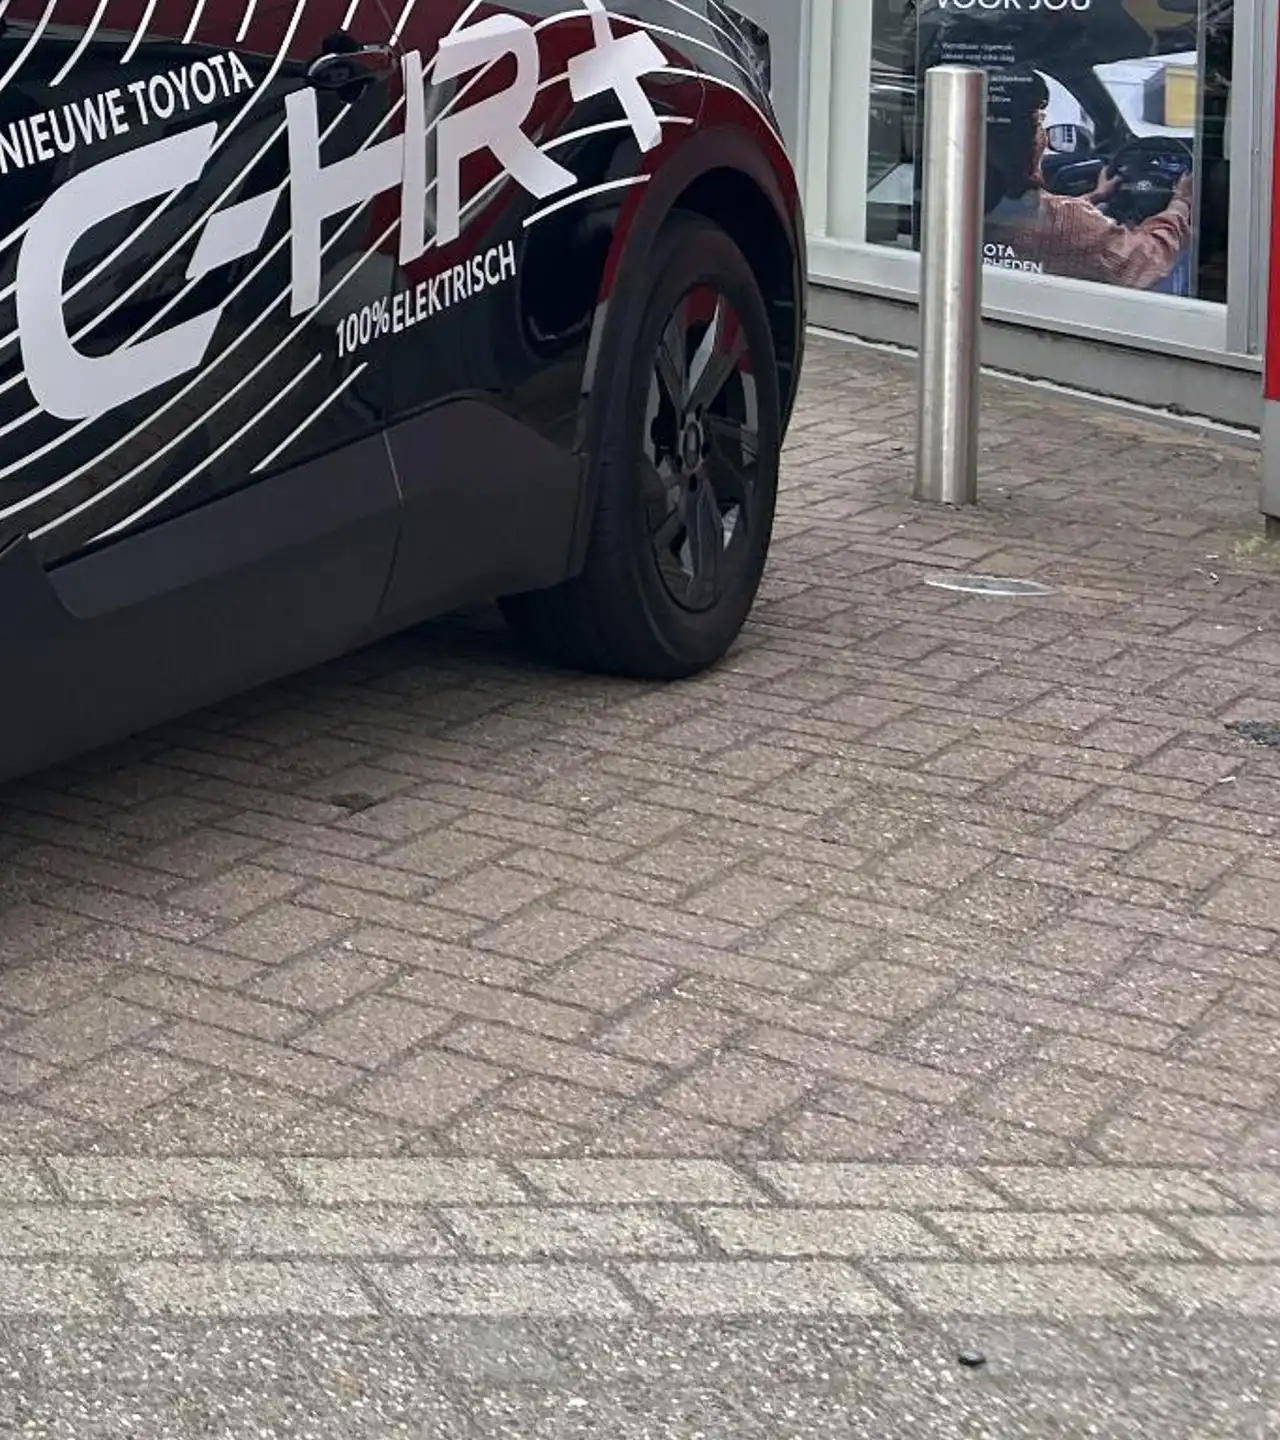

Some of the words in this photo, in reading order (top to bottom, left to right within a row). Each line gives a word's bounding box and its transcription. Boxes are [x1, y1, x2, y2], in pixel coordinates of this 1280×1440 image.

[128, 50, 255, 126] TOYOTA
[983, 243, 1016, 258] OTA
[336, 295, 391, 358] 100%
[391, 239, 517, 334] ELEKTRISCH
